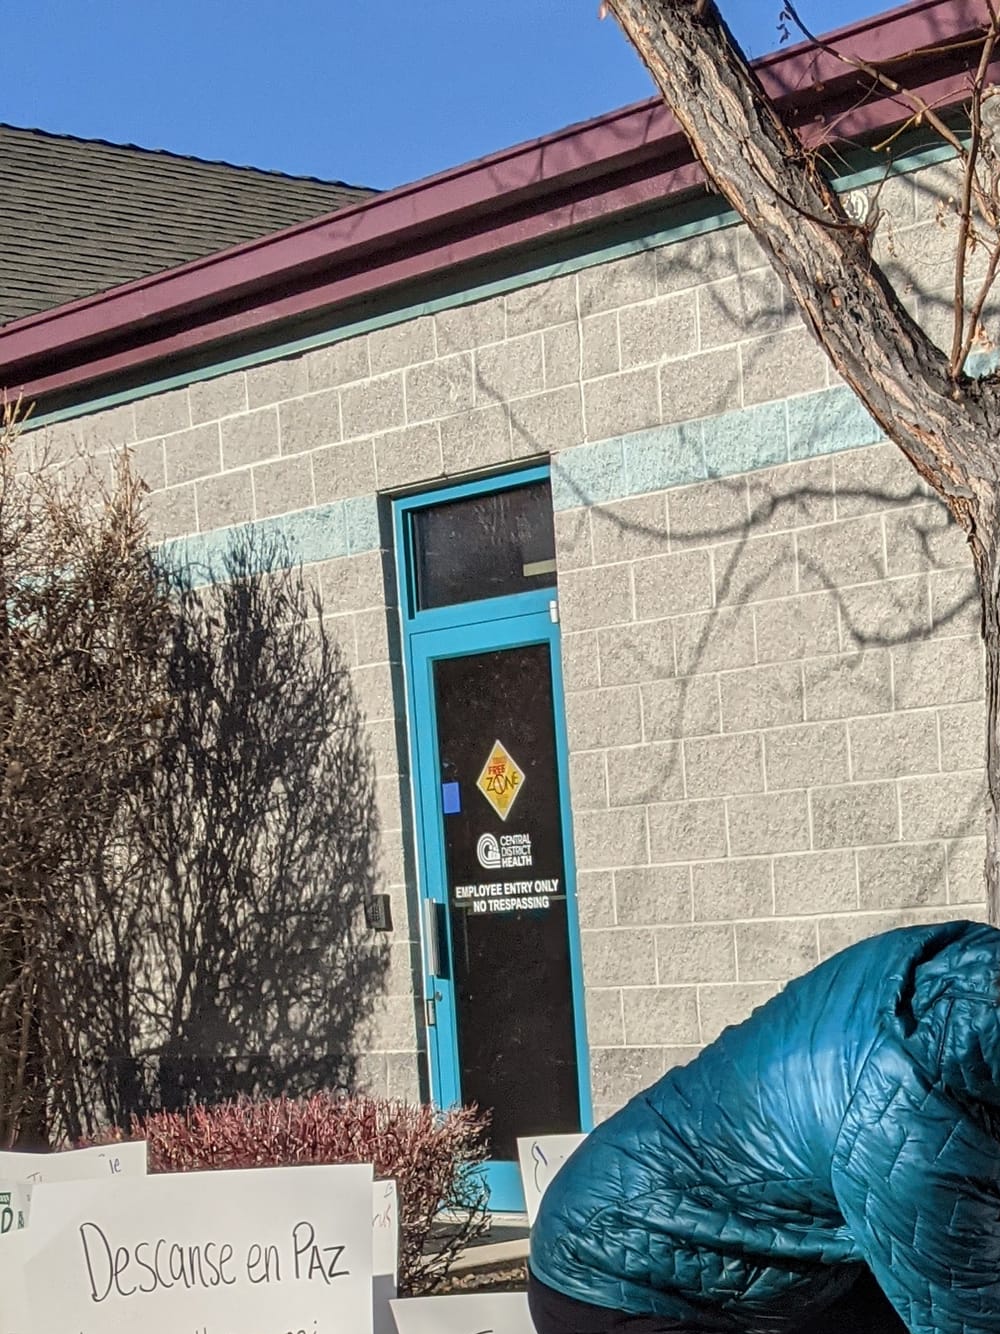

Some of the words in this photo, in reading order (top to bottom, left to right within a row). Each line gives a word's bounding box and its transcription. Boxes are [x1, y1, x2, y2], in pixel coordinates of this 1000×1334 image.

[500, 833, 531, 846] CENTRAL
[501, 844, 531, 857] DISTRICT
[502, 856, 532, 868] HEALTH
[455, 884, 502, 898] EMPLOYEE
[503, 882, 534, 895] ENTRY
[534, 879, 559, 892] ONLY
[473, 900, 487, 912] NO
[488, 896, 550, 911] TRESPASSING
[79, 1222, 236, 1302] Descanse
[247, 1238, 281, 1283] en
